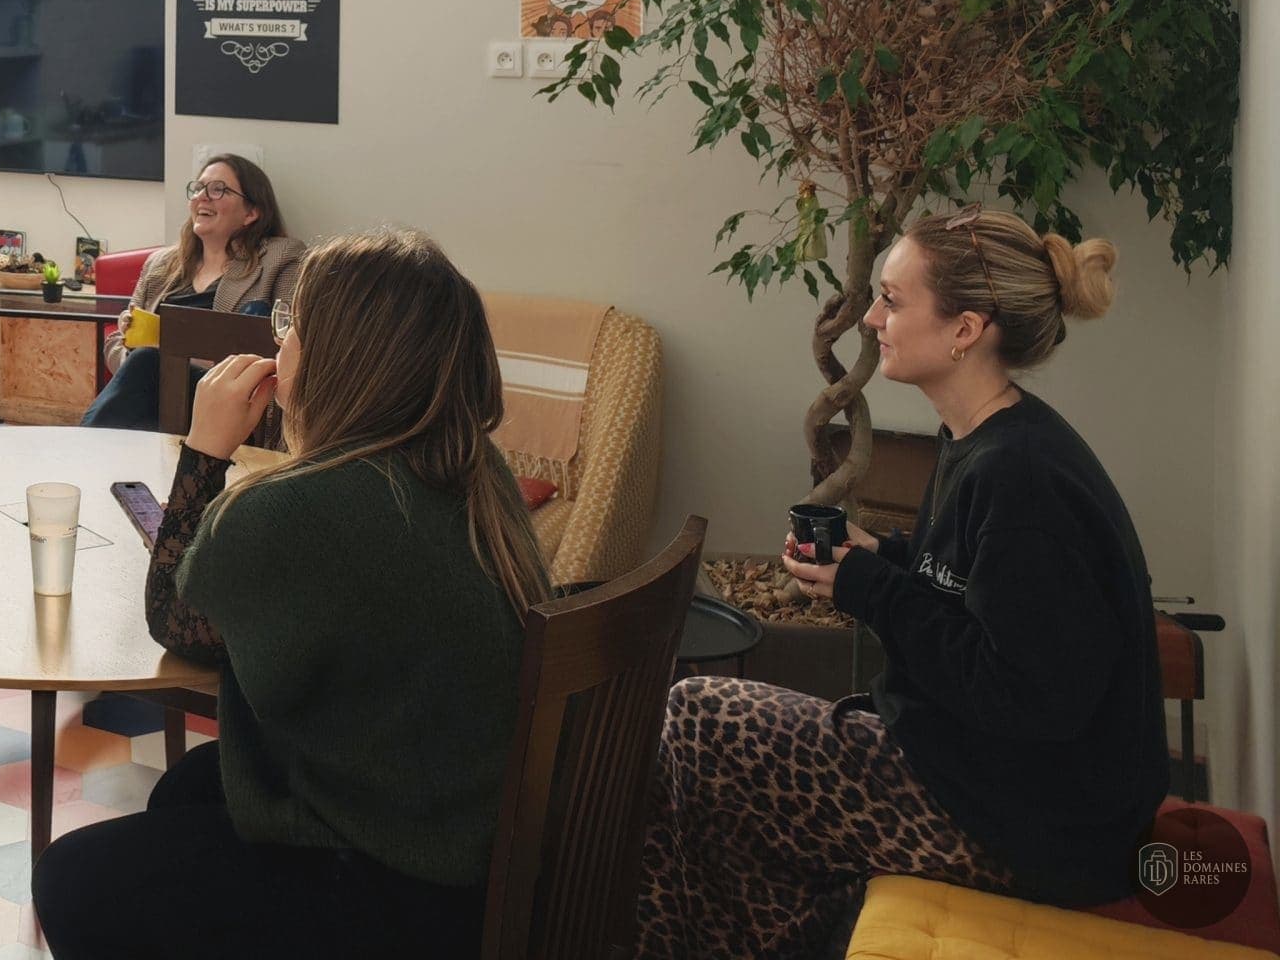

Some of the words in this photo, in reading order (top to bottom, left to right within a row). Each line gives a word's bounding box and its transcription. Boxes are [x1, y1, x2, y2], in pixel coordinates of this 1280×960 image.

[205, 0, 216, 11] IS
[217, 0, 235, 12] MY
[236, 0, 308, 13] SUPERPOWER
[219, 23, 255, 33] WHAT'S
[257, 23, 287, 33] YOURS
[918, 552, 934, 577] Be
